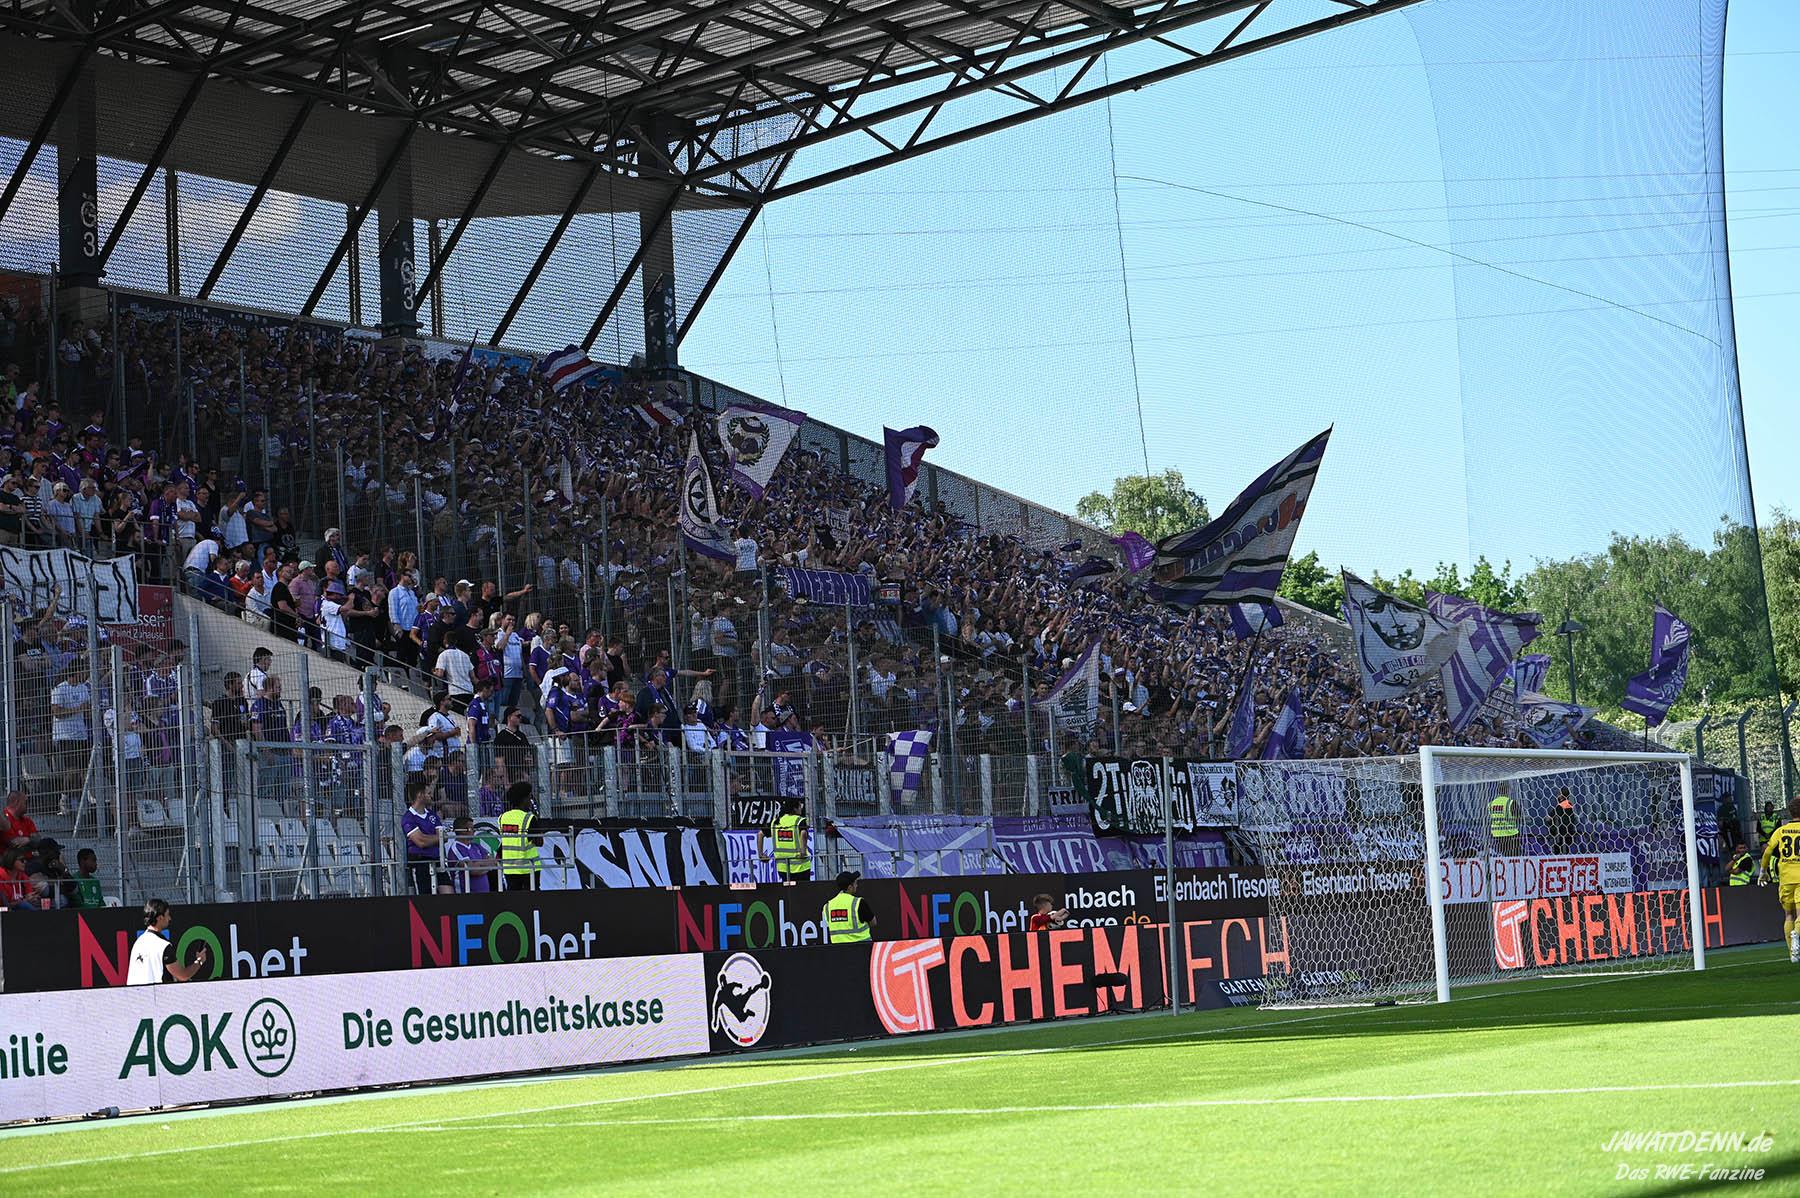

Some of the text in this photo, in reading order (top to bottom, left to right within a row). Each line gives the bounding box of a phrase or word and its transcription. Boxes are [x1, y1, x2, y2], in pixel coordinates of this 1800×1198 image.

[1408, 668, 1420, 679] 23
[1229, 873, 1281, 899] Tresore
[1303, 867, 1412, 896] Eisenbach Tresore
[1495, 859, 1537, 897] BTD
[78, 912, 307, 987] NObet
[343, 995, 664, 1050] Die Gesundheitskasse
[118, 1012, 238, 1080] AOK
